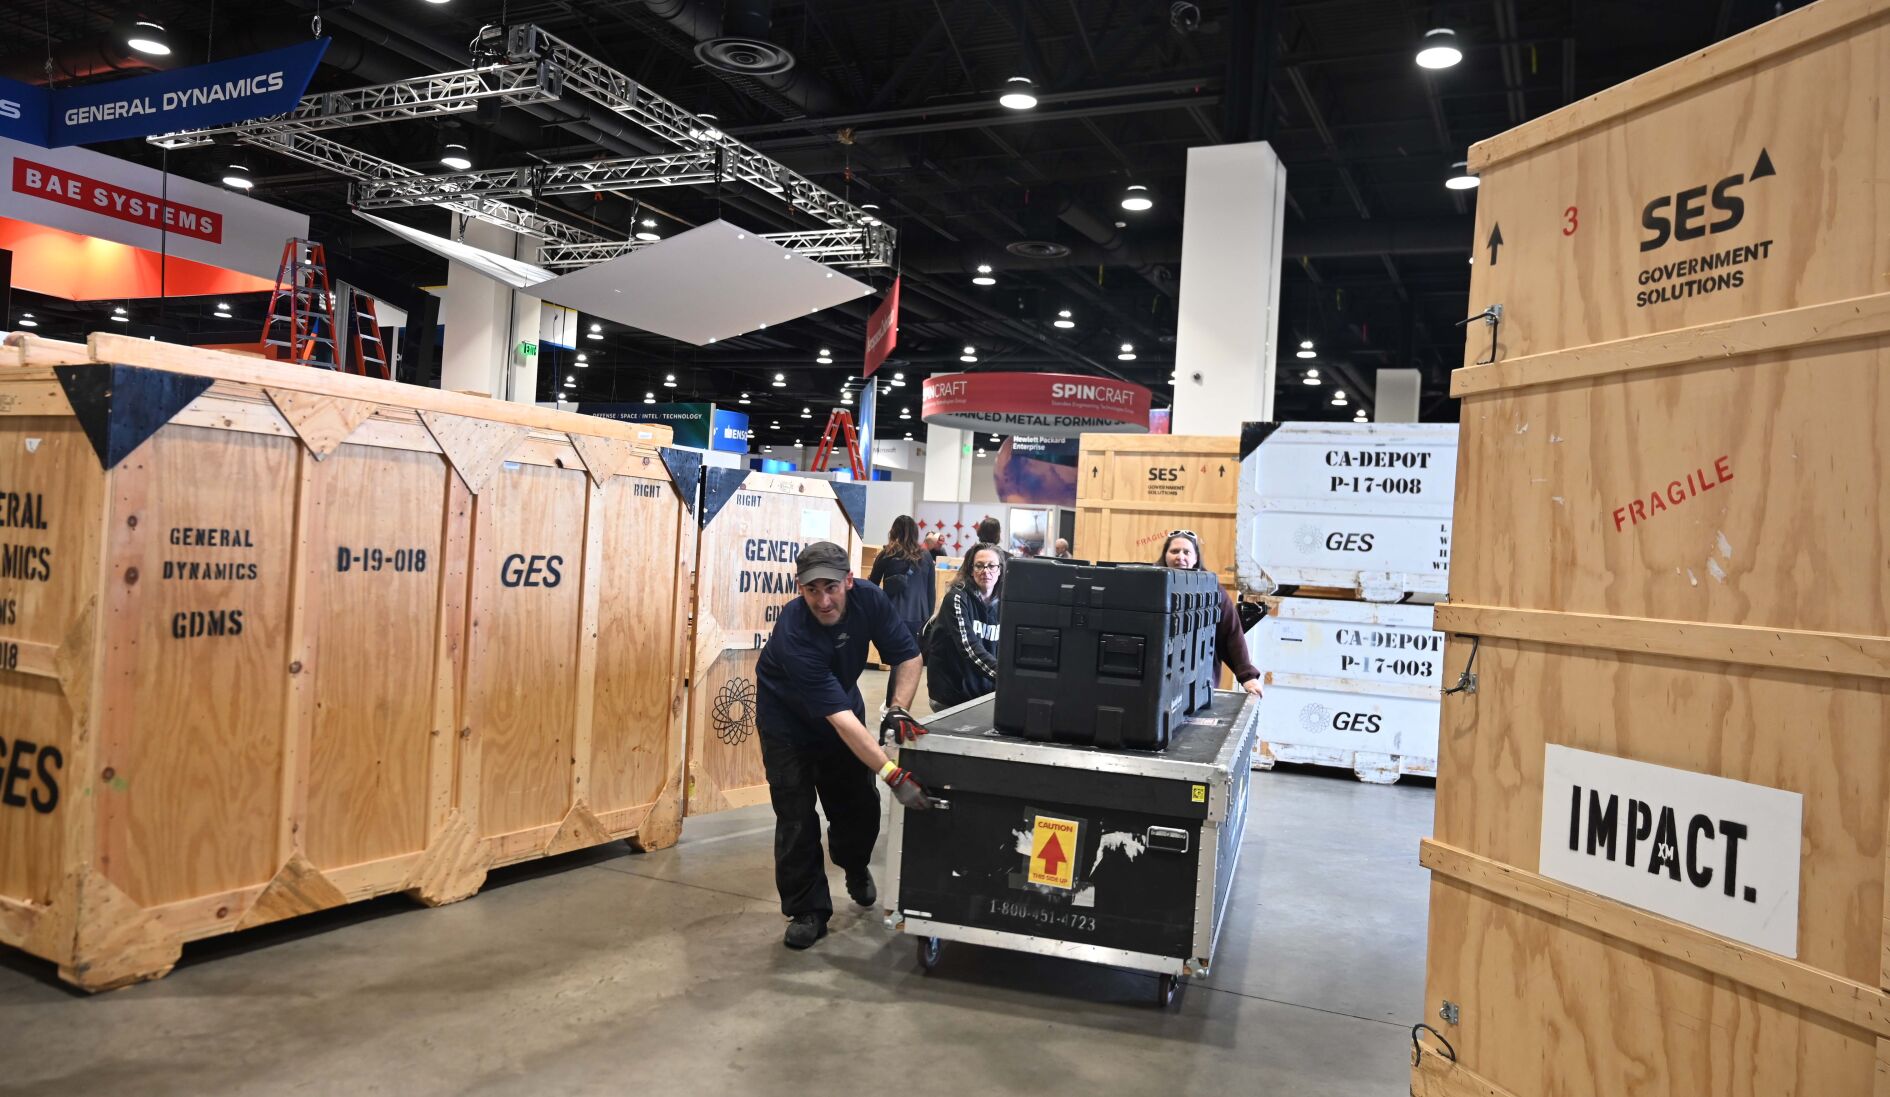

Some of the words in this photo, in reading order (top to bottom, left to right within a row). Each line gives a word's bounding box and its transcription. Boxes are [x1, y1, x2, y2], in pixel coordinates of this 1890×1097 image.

[64, 96, 157, 126] GENERAL
[163, 71, 284, 111] DYNAMICS
[25, 168, 83, 200] BAE
[93, 187, 213, 234] SYSTEMS
[1562, 206, 1578, 236] 3
[1640, 173, 1745, 253] SES
[1638, 240, 1773, 286] GOVERNMENT
[1636, 270, 1744, 308] SOLUTIONS
[1051, 383, 1134, 405] SPINCRAFT
[945, 412, 1001, 422] ANCED
[1005, 414, 1050, 426] METAL
[1012, 443, 1046, 452] Enterprise
[1040, 436, 1066, 444] Packard
[1200, 464, 1207, 474] 4
[1325, 451, 1431, 469] CA-DEPOT
[1148, 467, 1178, 482] SES
[1330, 476, 1422, 495] P-17-008
[634, 484, 660, 499] RIGHT
[736, 494, 762, 509] RIGHT
[1613, 455, 1734, 533] FRAGILE
[170, 527, 254, 548] GENERAL
[1441, 524, 1447, 532] L
[745, 539, 808, 563] GENER
[1325, 532, 1374, 552] GES
[1440, 549, 1447, 557] H
[0, 543, 51, 582] MICS
[163, 561, 258, 581] DYNAMICS
[337, 547, 427, 573] D-19-018
[501, 553, 563, 588] GES
[739, 570, 801, 594] DYNAM
[172, 610, 243, 639] GDMS
[1336, 628, 1442, 652] CA-DEPOT
[1341, 655, 1433, 677] P-17-003
[1332, 711, 1381, 733] GES
[1038, 821, 1073, 833] CAUTION
[1569, 785, 1757, 903] IMPACT.
[1033, 872, 1045, 880] THIS
[1045, 875, 1059, 883] SIDE
[990, 899, 1096, 931] 1-800-451-4723
